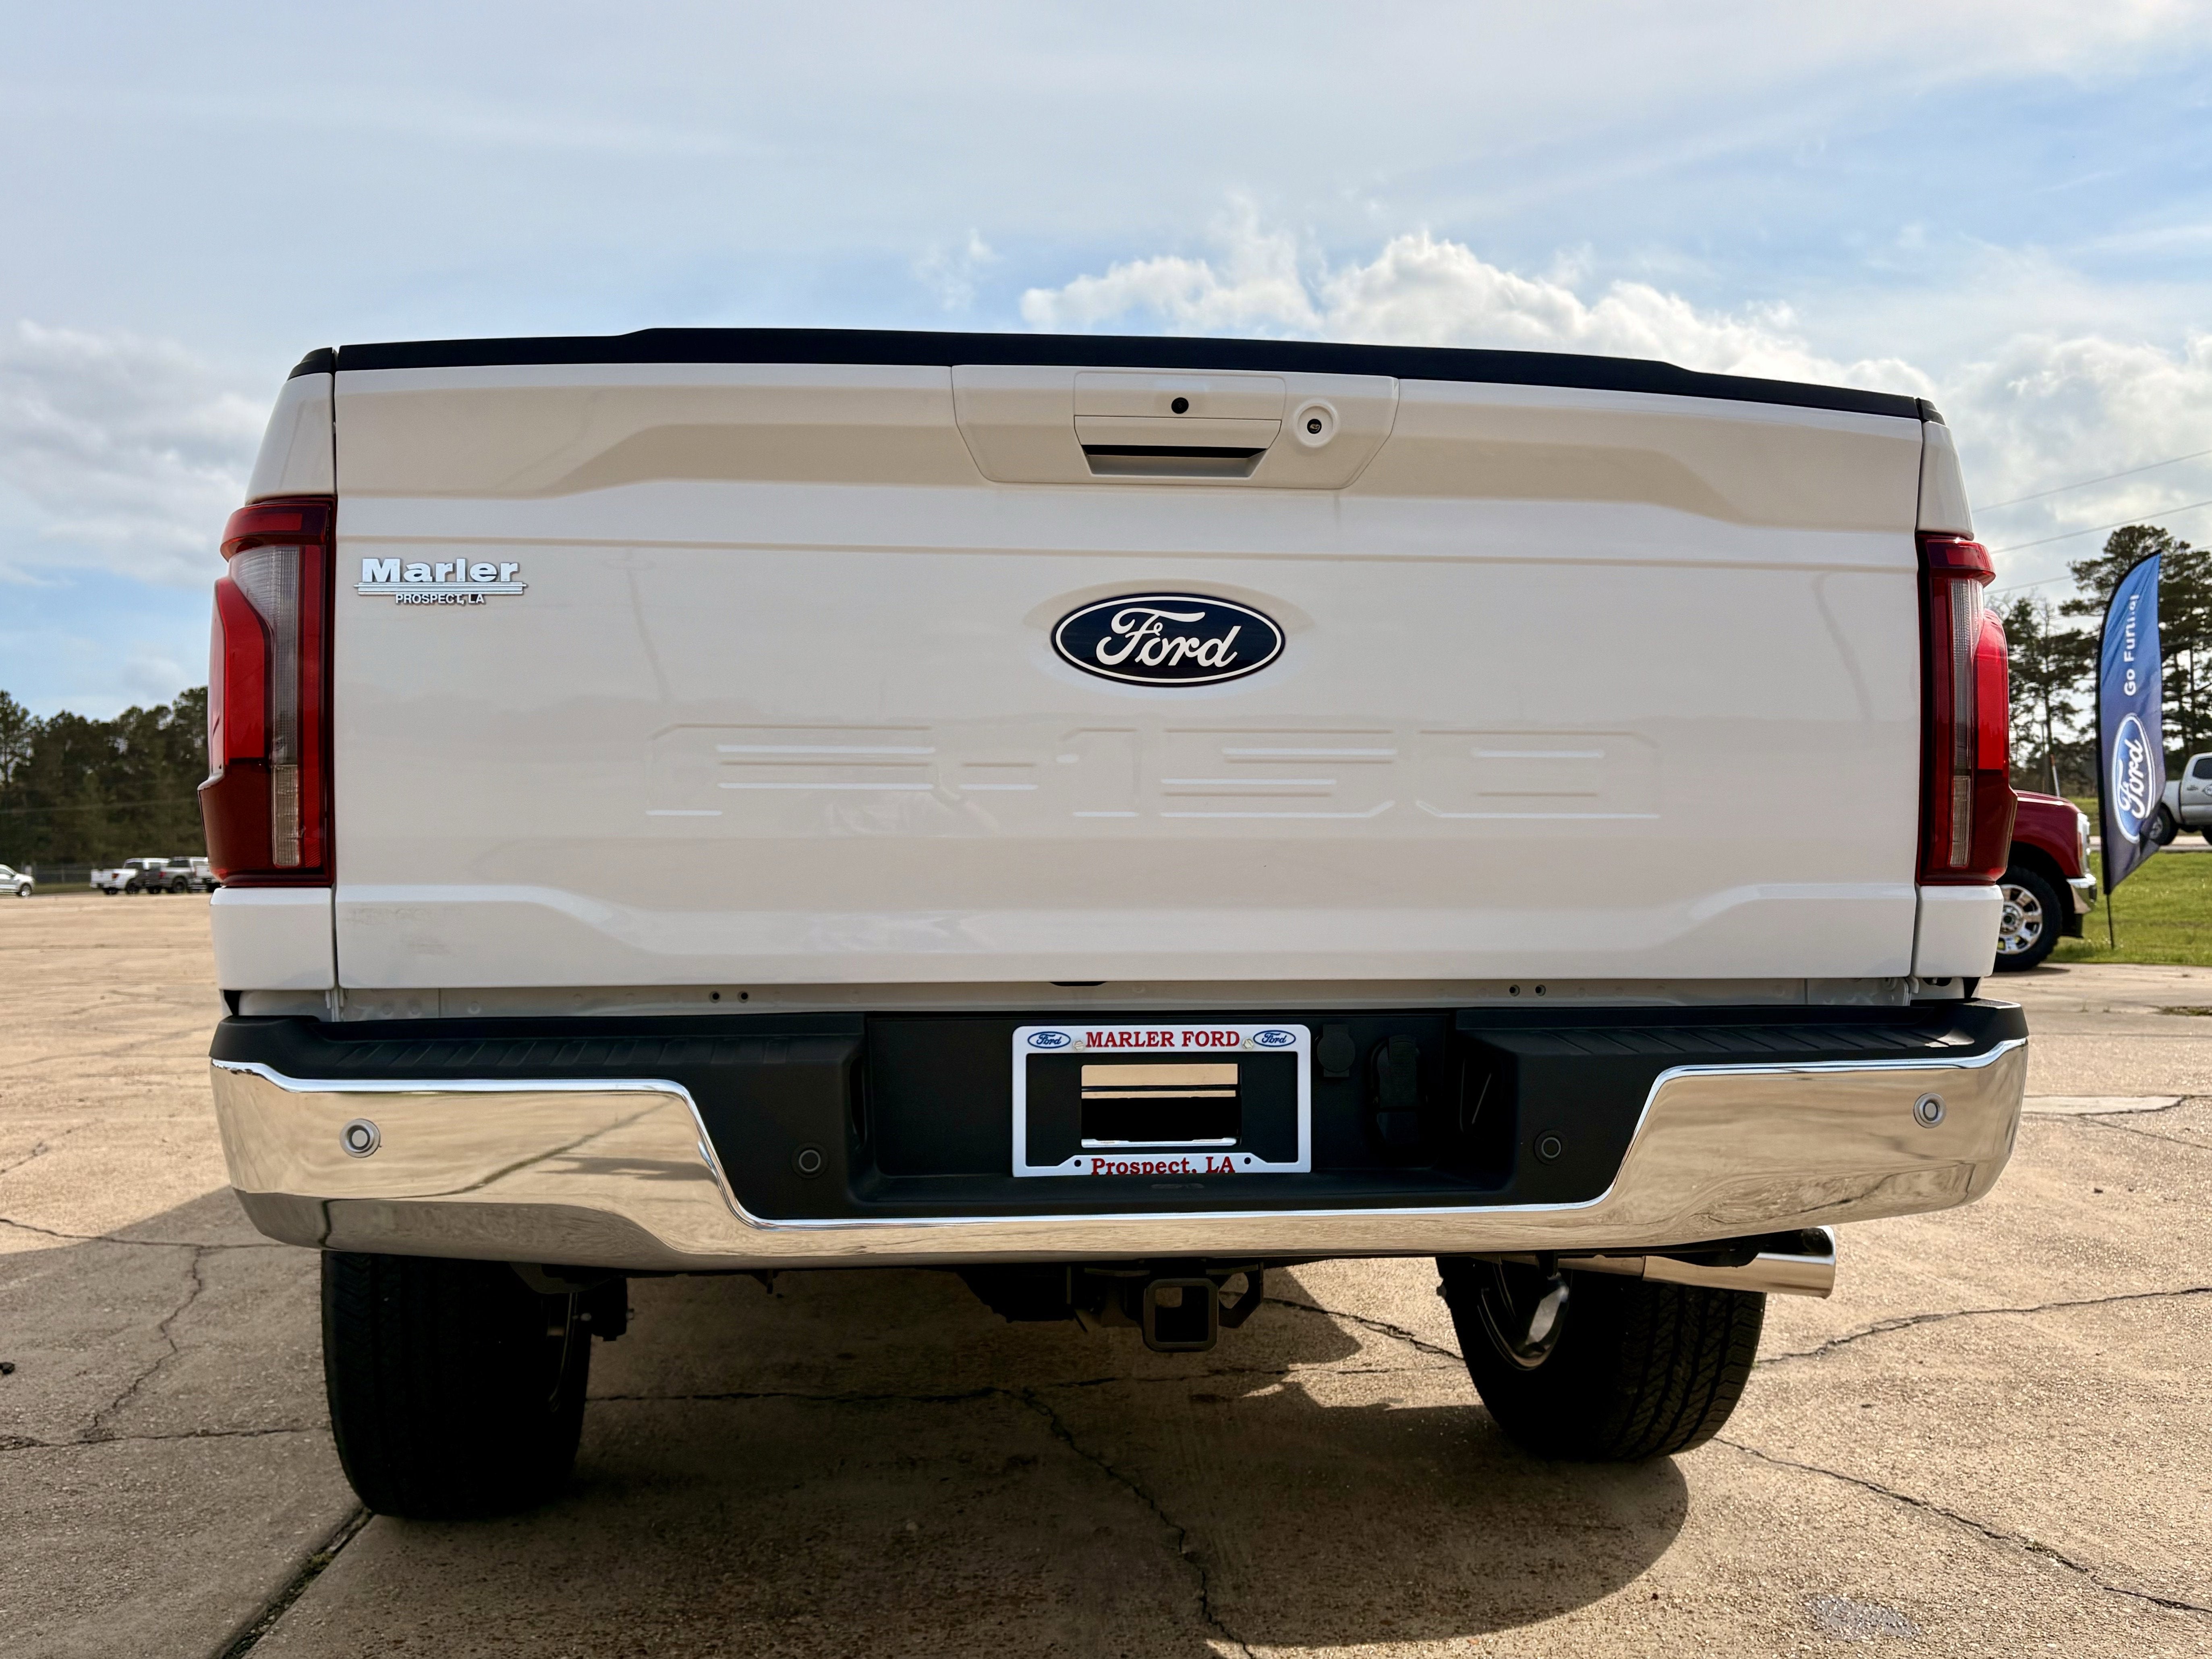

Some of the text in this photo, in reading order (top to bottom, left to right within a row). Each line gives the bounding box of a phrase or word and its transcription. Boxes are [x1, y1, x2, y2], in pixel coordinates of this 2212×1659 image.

[362, 558, 519, 583] Marler
[396, 594, 484, 604] PROSPECT, LA
[1096, 608, 1242, 668] Ford
[2124, 668, 2136, 696] Go
[2117, 738, 2145, 819] Ford
[1086, 1031, 1240, 1047] MARLER FORD
[1206, 1156, 1236, 1174] LA
